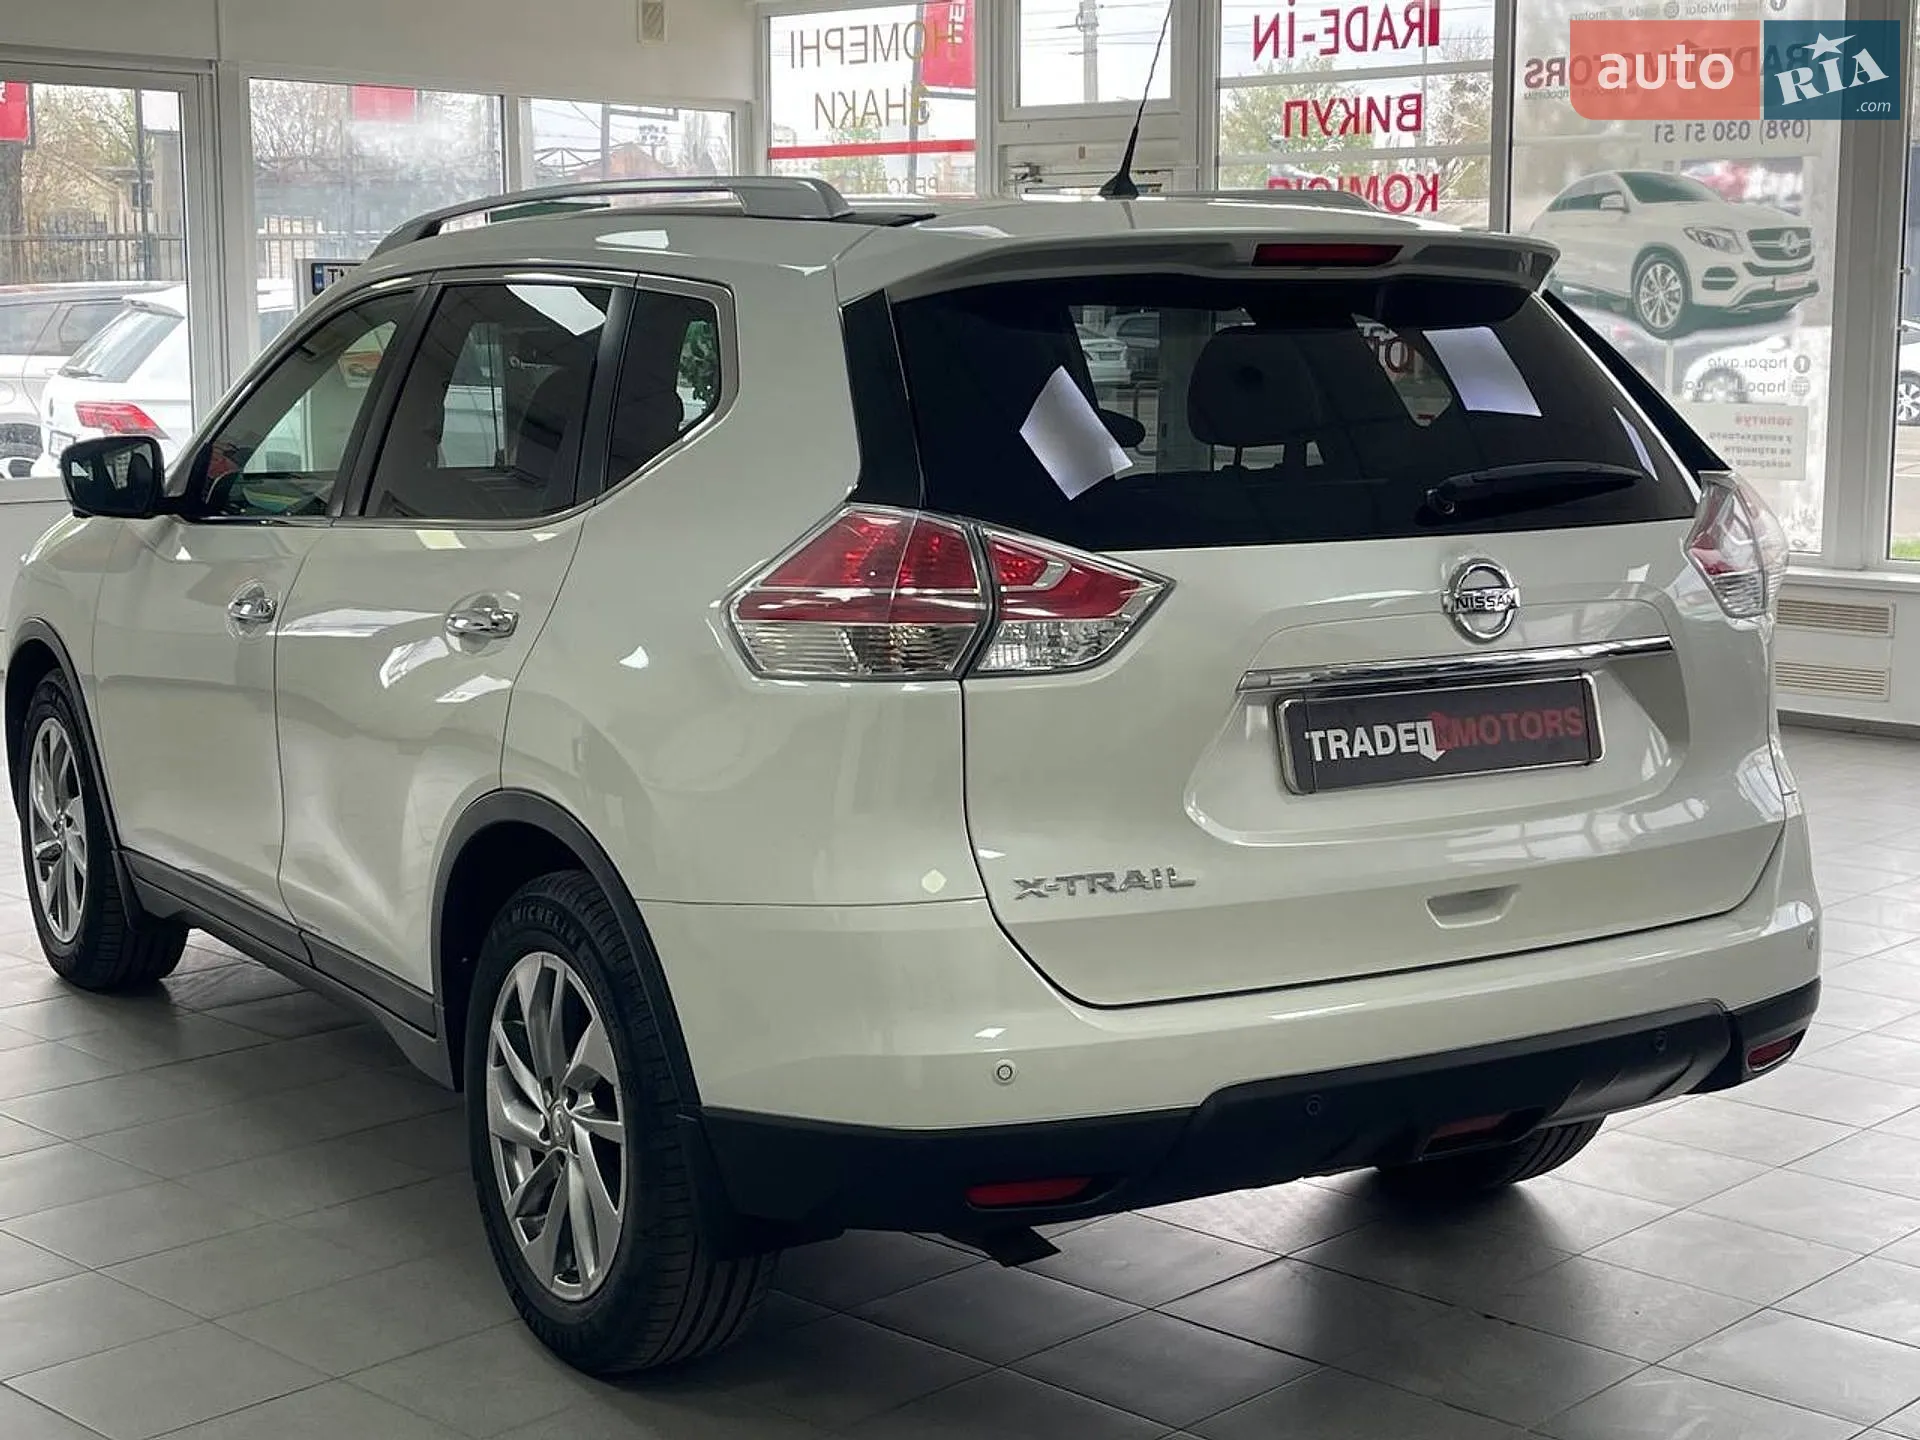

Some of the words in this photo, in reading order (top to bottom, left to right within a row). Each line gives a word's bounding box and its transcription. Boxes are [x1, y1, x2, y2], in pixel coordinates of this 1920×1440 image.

[1455, 592, 1516, 609] NISSAN
[1453, 707, 1584, 749] MOTORS
[1013, 866, 1196, 901] X-TRAIL
[511, 903, 579, 945] MICHELIN
